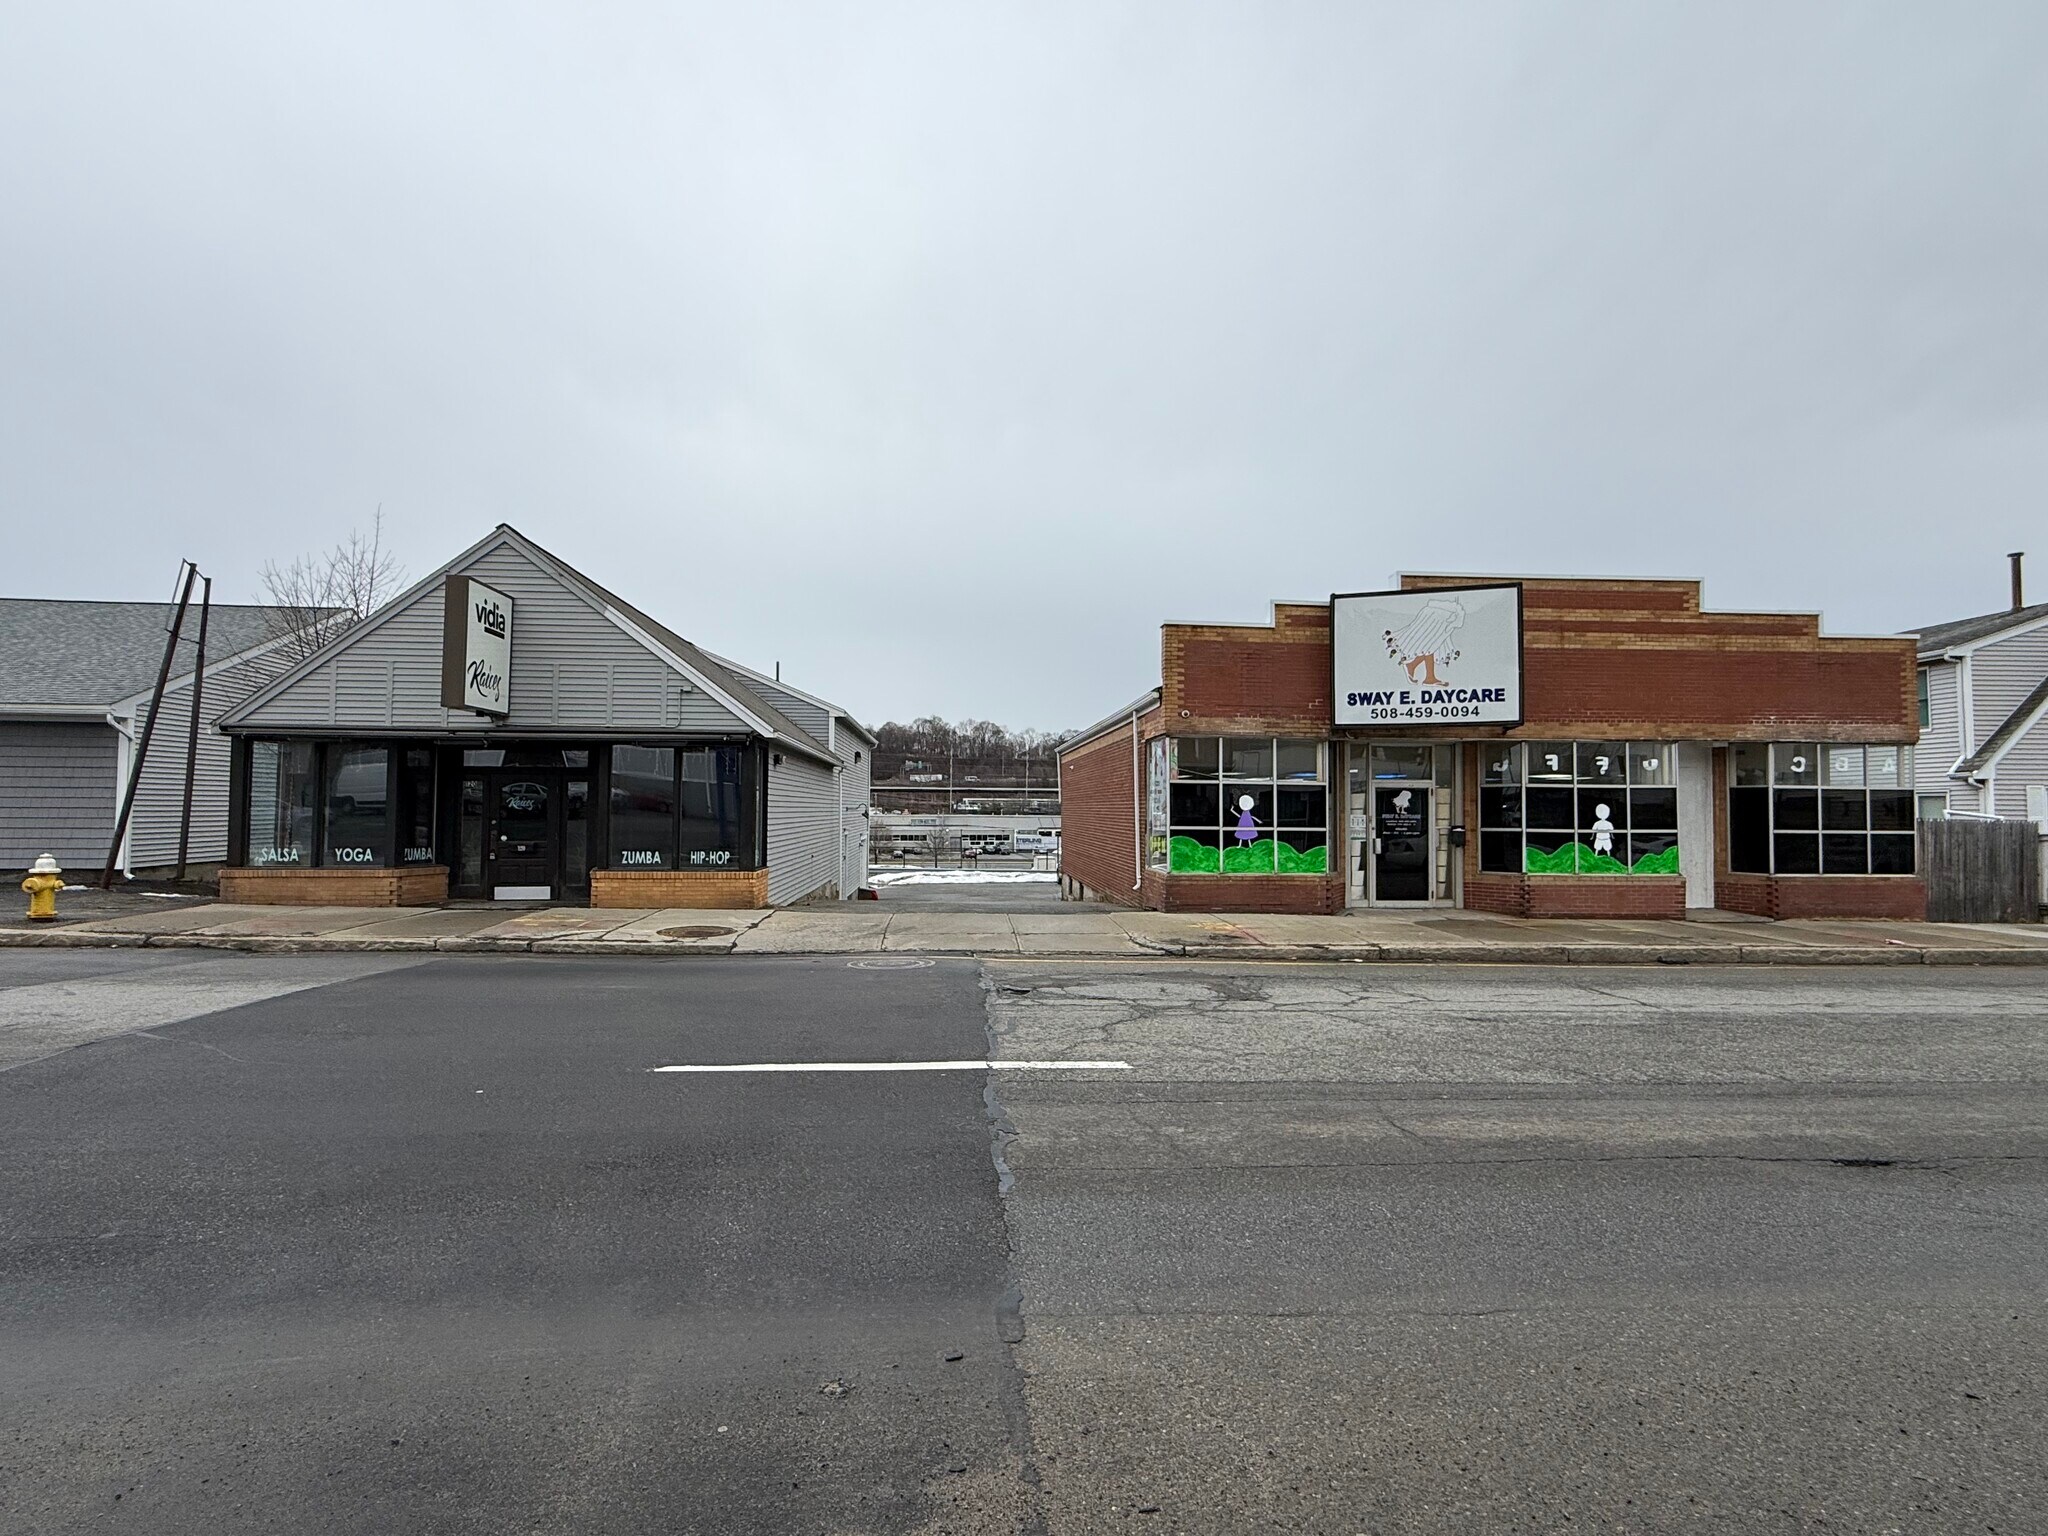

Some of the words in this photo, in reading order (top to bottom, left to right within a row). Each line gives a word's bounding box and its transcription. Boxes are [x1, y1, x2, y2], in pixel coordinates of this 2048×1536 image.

[475, 598, 505, 632] vidia
[1347, 691, 1394, 706] SWAY
[1400, 691, 1415, 705] E.
[1421, 688, 1506, 704] DAYCARE
[1370, 706, 1480, 719] 508-459-0094
[261, 847, 299, 862] SALSA
[335, 848, 374, 862] YOGA
[621, 851, 662, 864] ZUMBA
[690, 851, 731, 864] HIP-HOP
